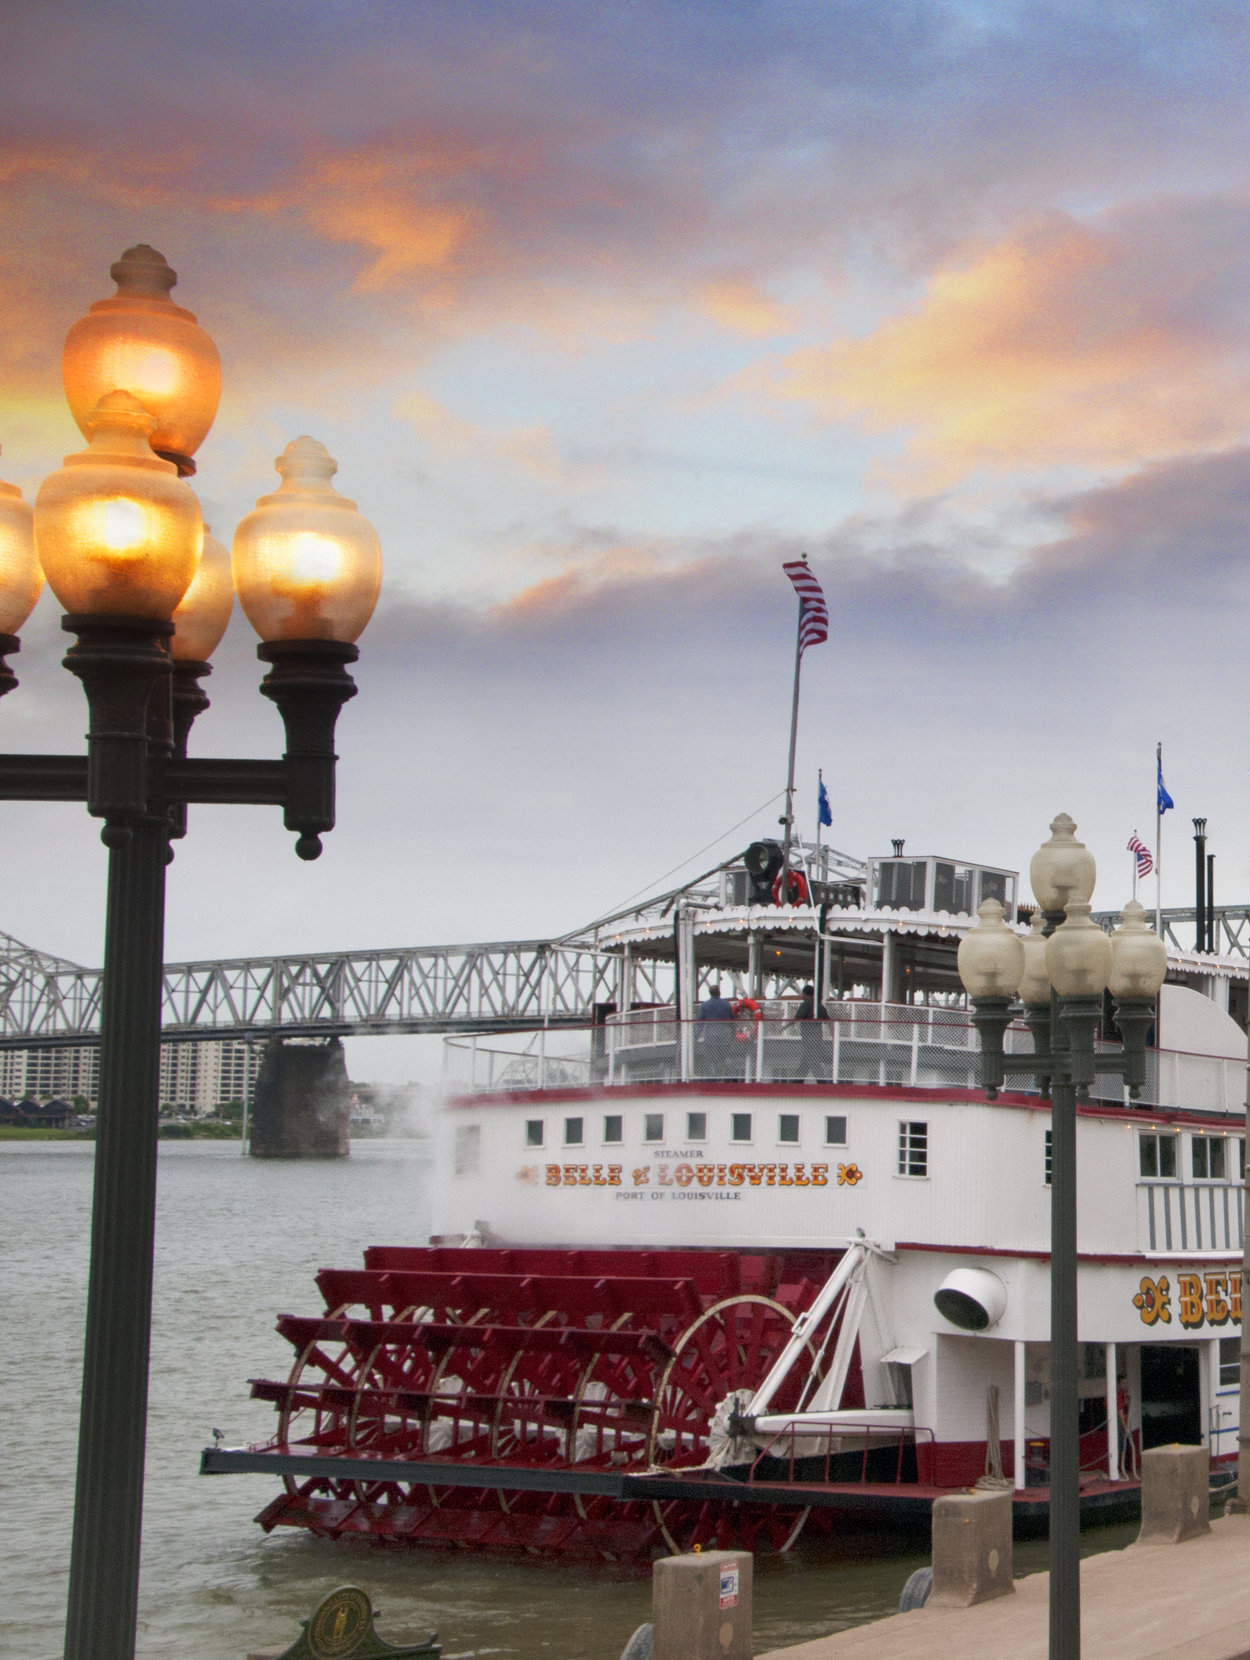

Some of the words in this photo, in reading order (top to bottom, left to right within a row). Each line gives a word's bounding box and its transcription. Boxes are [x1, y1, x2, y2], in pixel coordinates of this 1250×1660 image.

[654, 1150, 704, 1158] STEAMER
[545, 1164, 622, 1186] BELLE
[658, 1163, 828, 1187] LOUISVILLE
[616, 1192, 646, 1200] PORT
[651, 1192, 666, 1200] OF
[672, 1192, 741, 1200] LOUISVILLE
